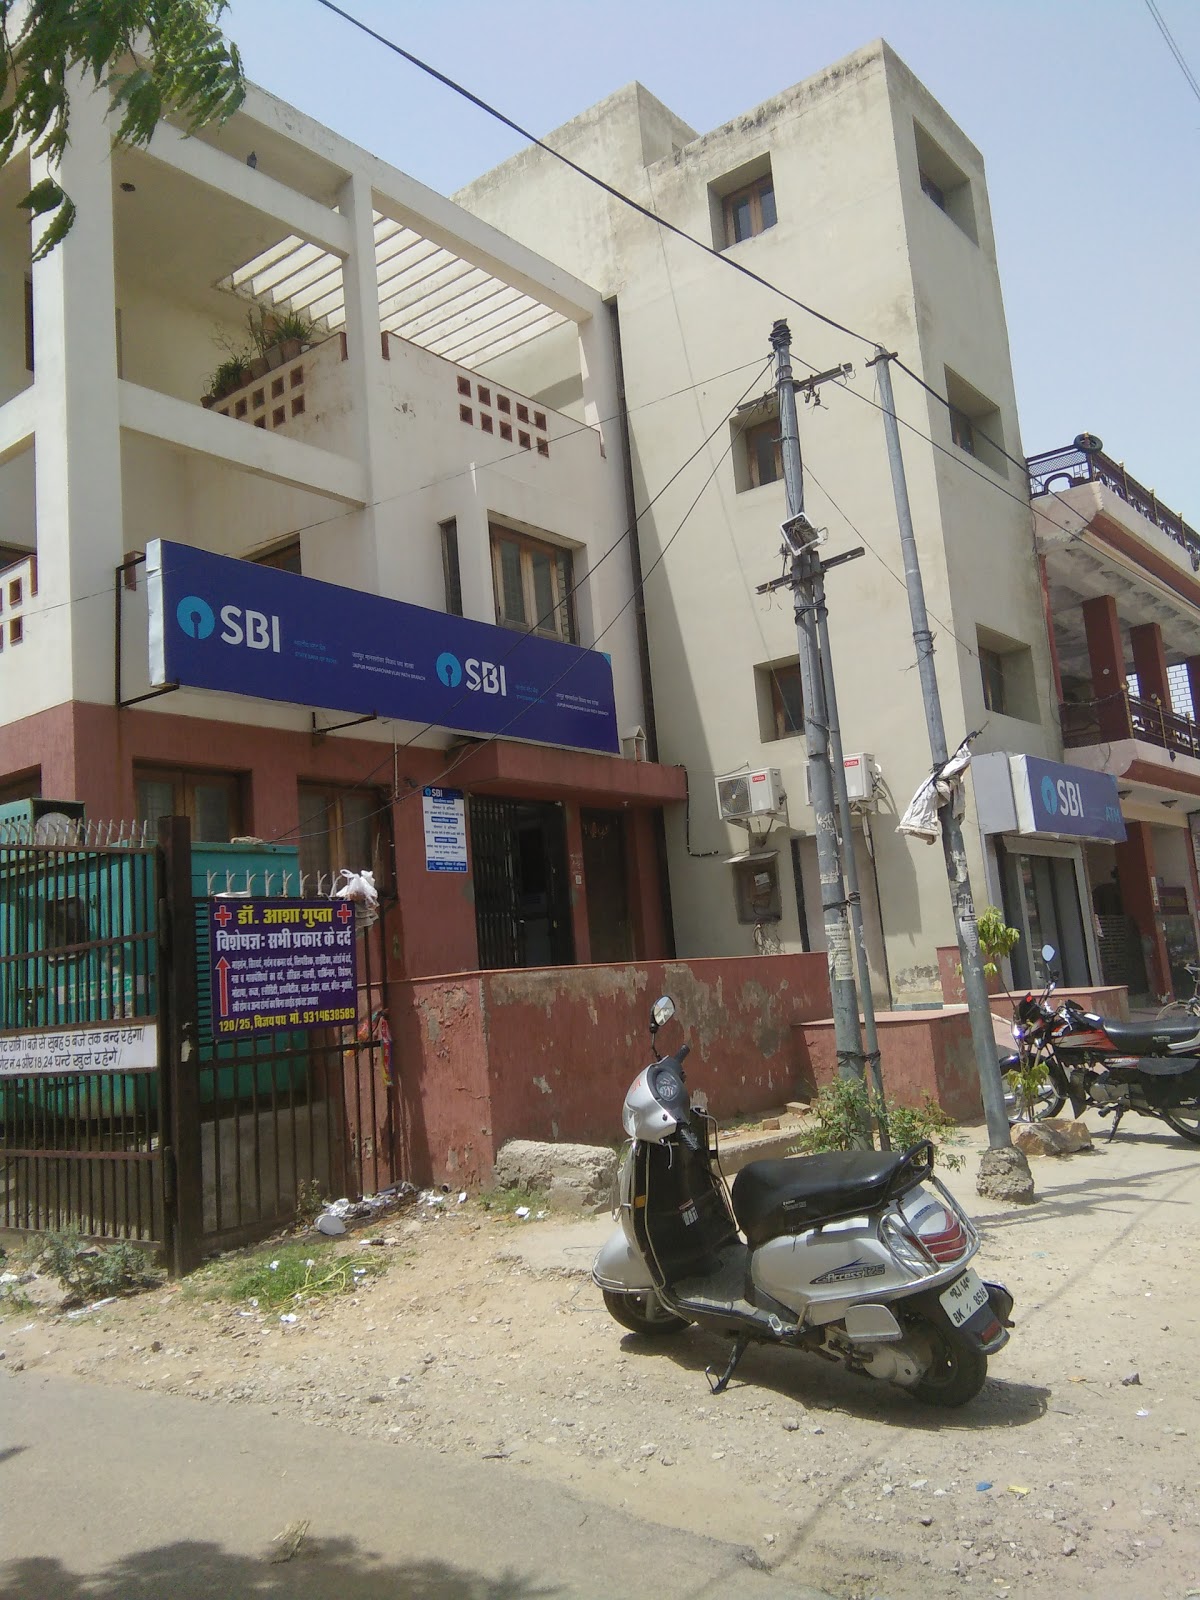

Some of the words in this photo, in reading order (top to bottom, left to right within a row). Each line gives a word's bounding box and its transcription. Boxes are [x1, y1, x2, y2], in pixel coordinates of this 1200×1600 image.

[220, 604, 281, 653] SBI
[465, 658, 507, 696] SBI
[432, 788, 442, 798] SBI
[1057, 779, 1084, 818] SBI
[1105, 806, 1121, 823] ATM
[237, 905, 259, 924] डॉ.
[263, 908, 300, 924] आशा
[302, 908, 333, 928] गुप्ता
[268, 928, 291, 949] सभी
[292, 932, 322, 949] प्रकार
[324, 926, 335, 946] के
[336, 925, 352, 946] दर्द
[219, 1017, 254, 1032] 120/25,
[254, 1014, 274, 1028] विजय
[304, 1008, 355, 1023] 9314638589
[28, 1034, 38, 1051] बजे
[38, 1034, 46, 1050] से
[48, 1037, 64, 1053] सुबह
[64, 1035, 70, 1048] 5
[72, 1030, 86, 1048] बजे
[88, 1032, 102, 1046] तक
[102, 1031, 120, 1044] बन्द
[16, 1058, 21, 1070] 4
[22, 1053, 34, 1069] और
[72, 1048, 92, 1069] खुले
[826, 1270, 862, 1283] Access
[862, 1264, 886, 1278] 125
[952, 1308, 966, 1324] BK
